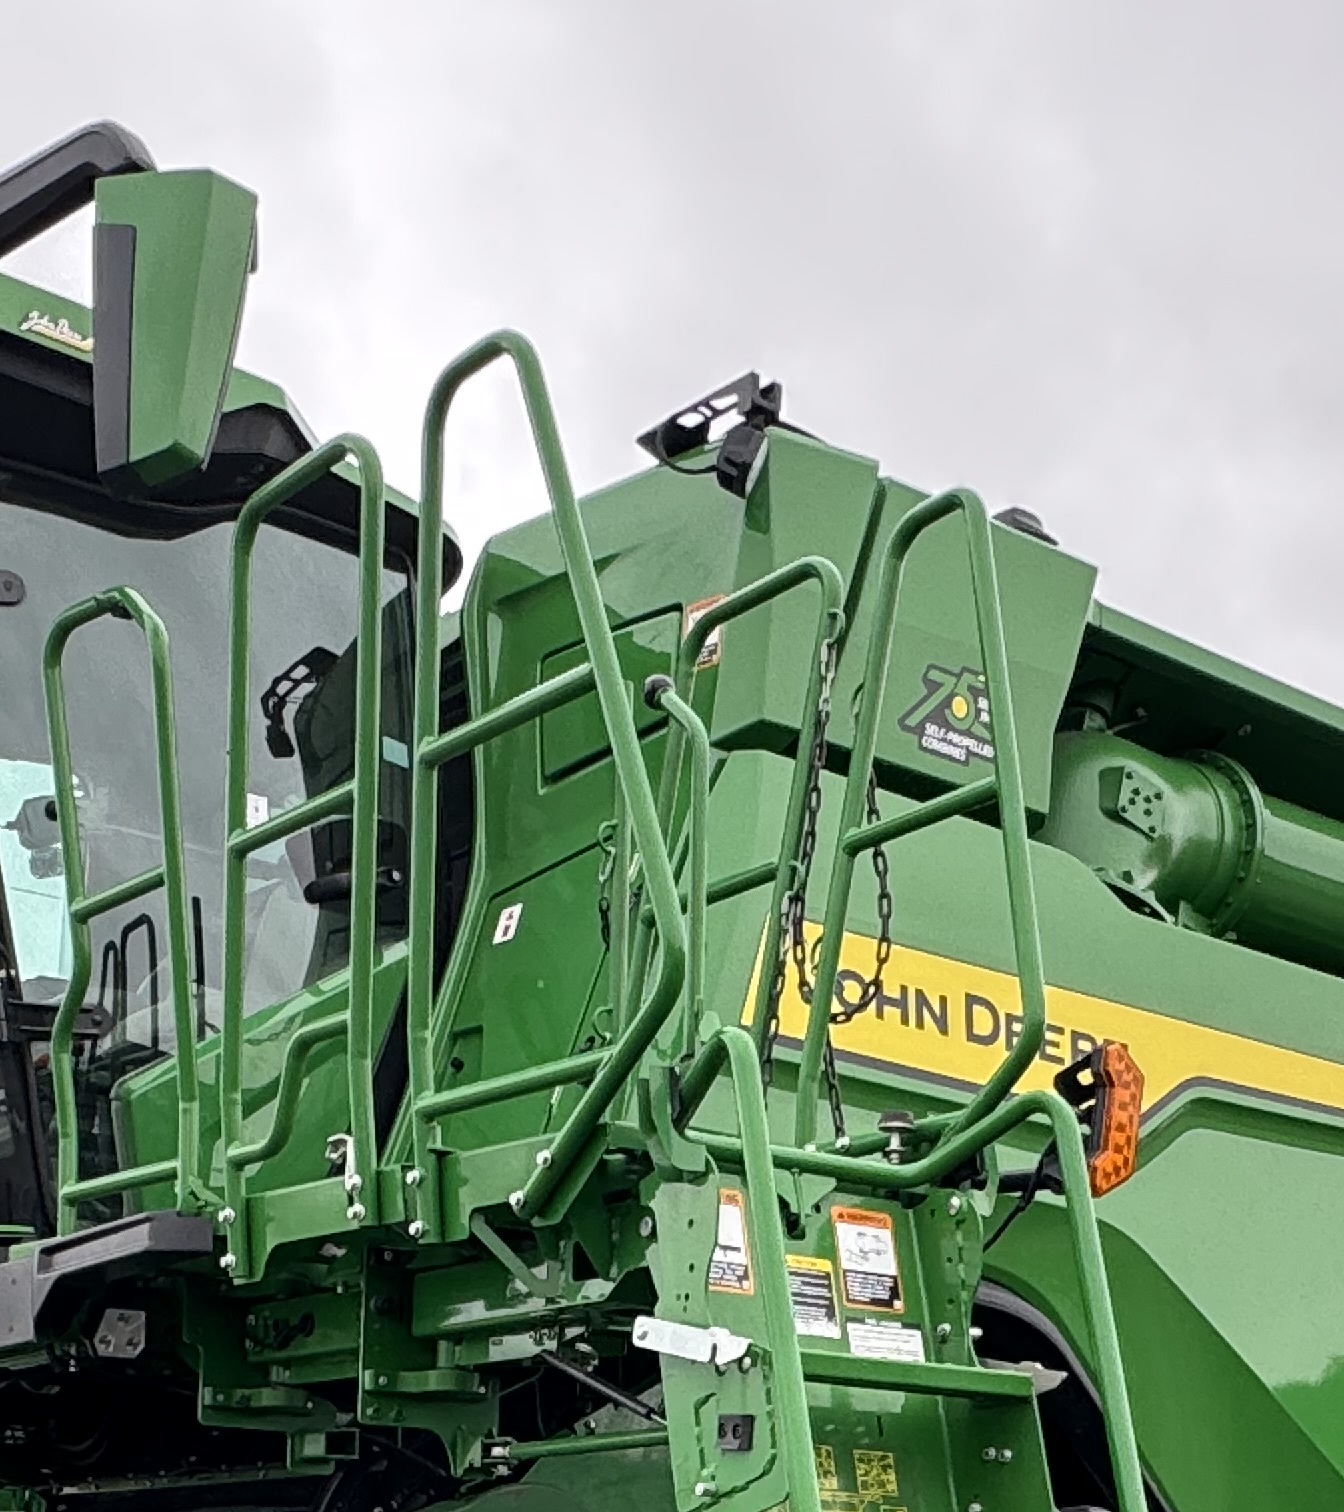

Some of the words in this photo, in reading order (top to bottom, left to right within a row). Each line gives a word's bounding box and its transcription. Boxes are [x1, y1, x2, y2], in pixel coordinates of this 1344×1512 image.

[901, 667, 987, 731] 75
[833, 968, 950, 1037] OHN
[964, 992, 1129, 1066] DEER
